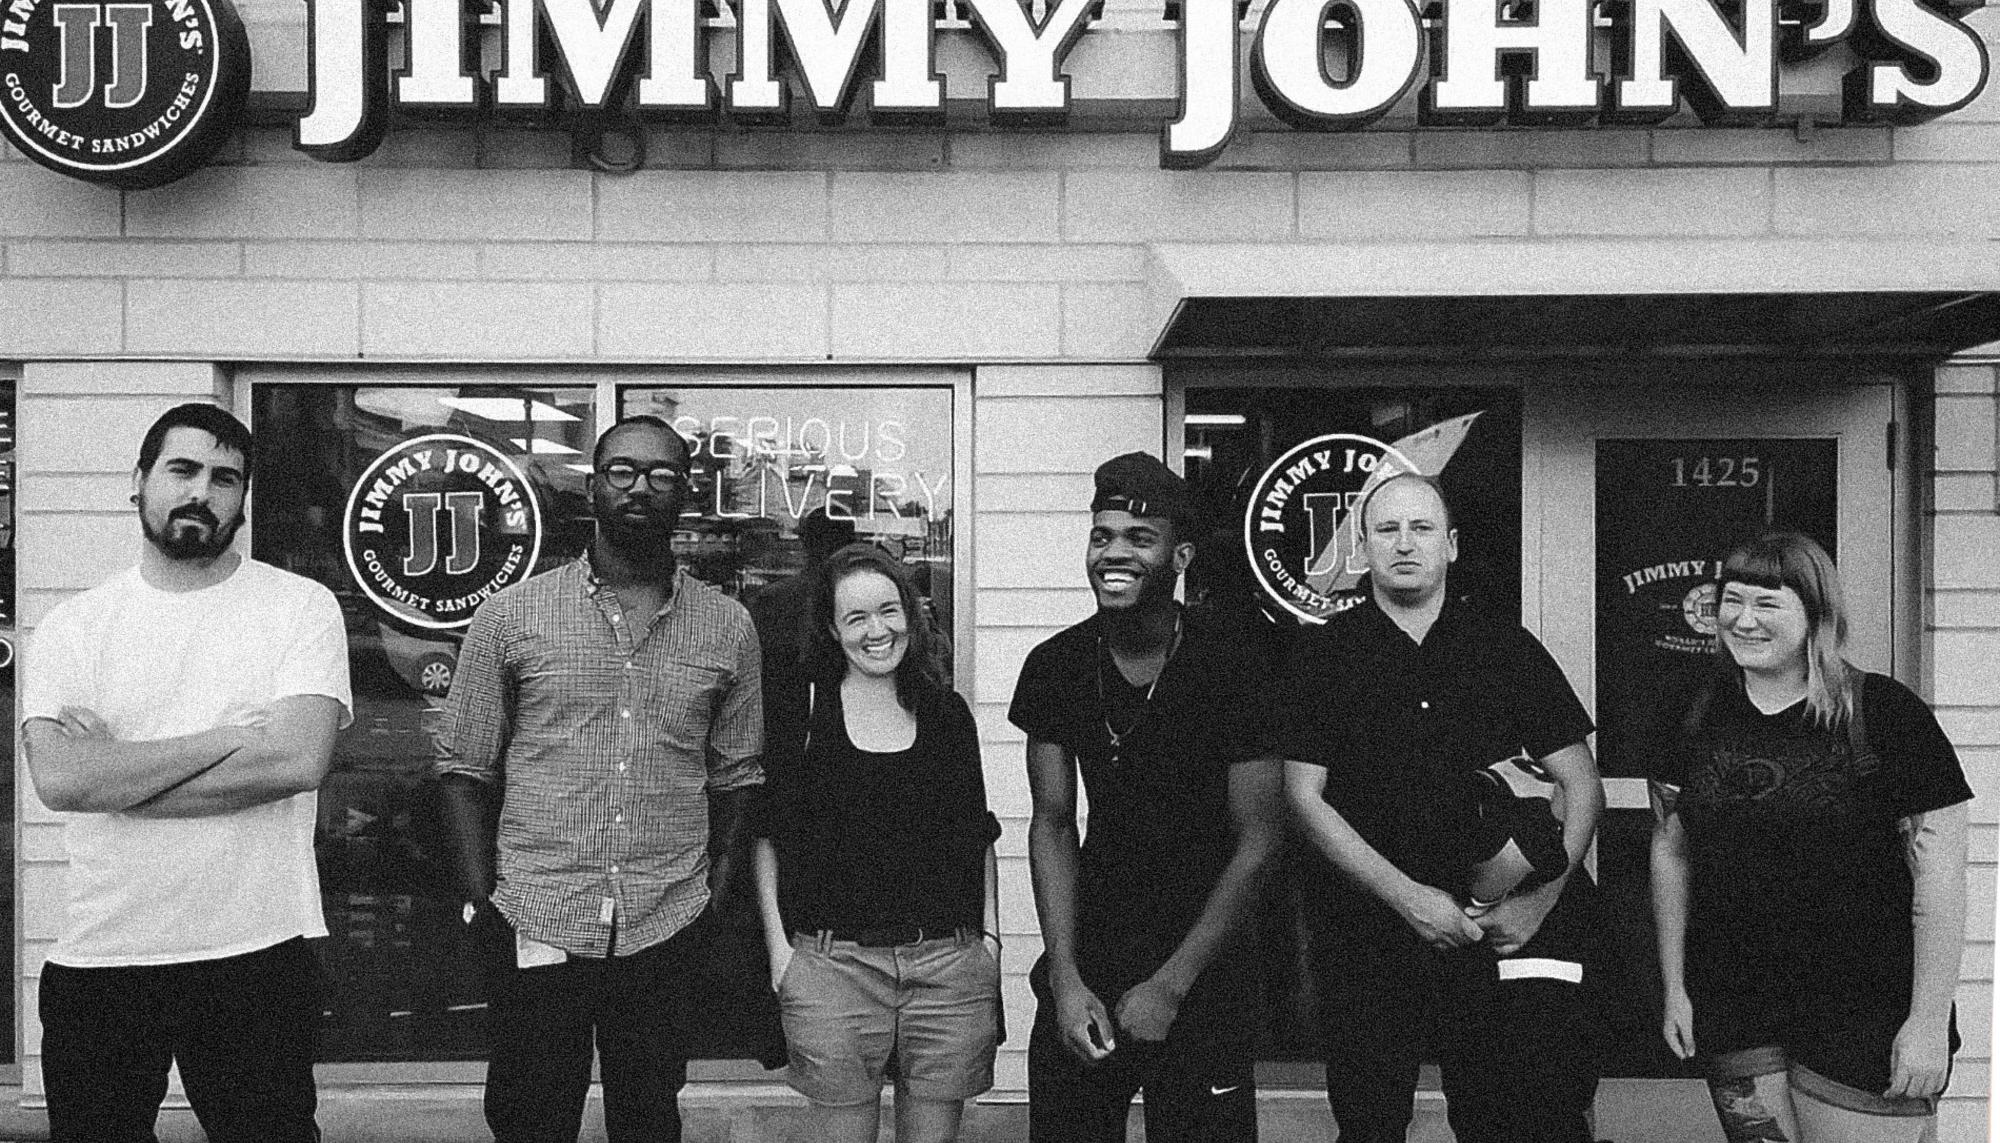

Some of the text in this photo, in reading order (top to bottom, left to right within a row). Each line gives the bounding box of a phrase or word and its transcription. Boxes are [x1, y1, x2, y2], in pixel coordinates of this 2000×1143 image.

[53, 4, 152, 108] JJ
[299, 0, 1982, 151] JIMMY JOHN'S
[5, 72, 199, 153] GOURMET SANDWICHES
[673, 416, 905, 461] SERIOUS
[1671, 457, 1760, 487] 1425
[359, 449, 528, 533] JIMMY JOHN'S
[1260, 450, 1331, 533] JIMMY
[403, 492, 484, 576] JJ
[363, 544, 523, 612] GOURMET SANDWICHES
[1264, 549, 1331, 609] GOURMET
[1623, 560, 1705, 594] JIMMY
